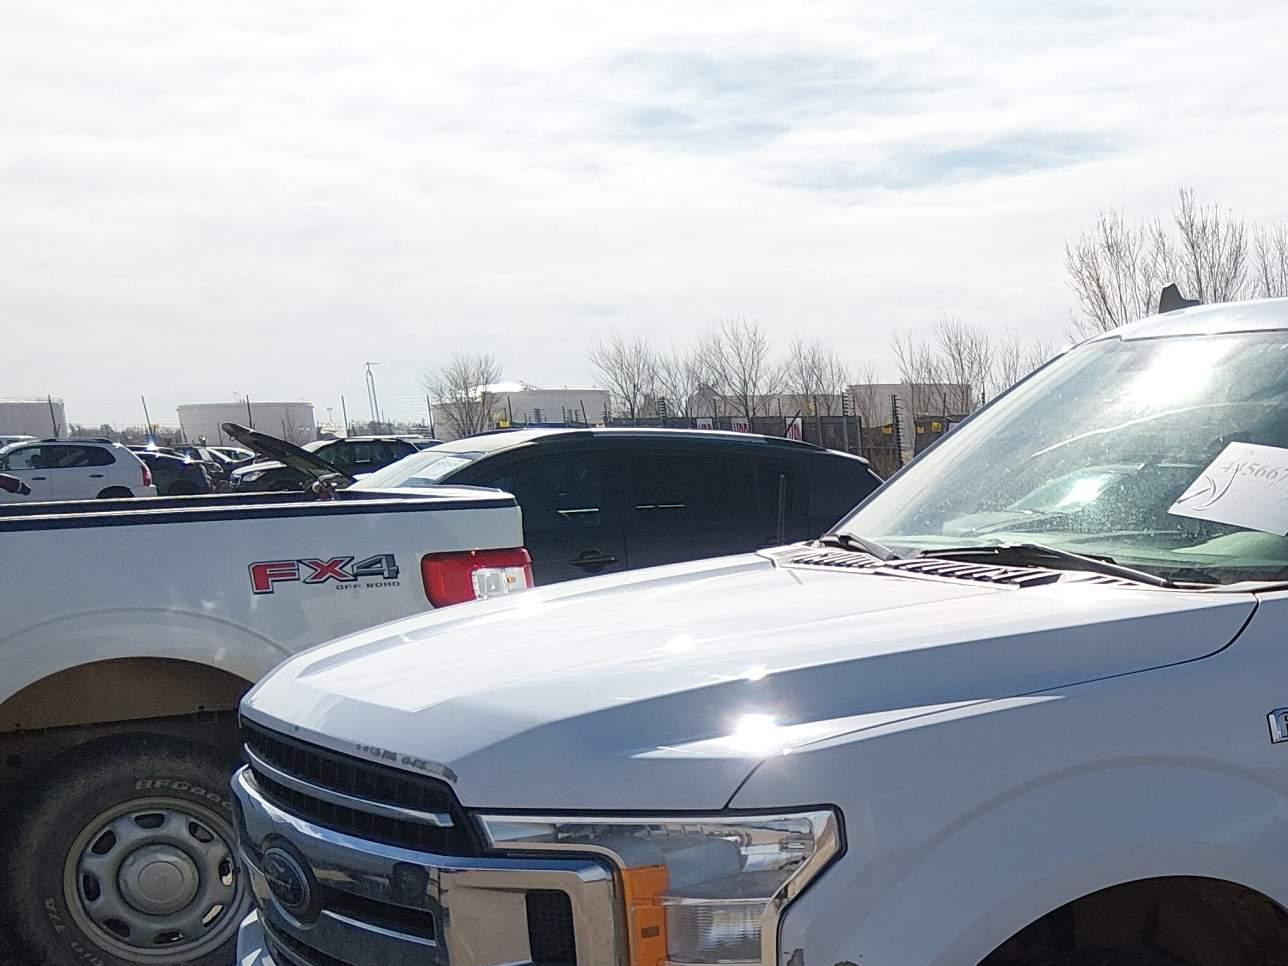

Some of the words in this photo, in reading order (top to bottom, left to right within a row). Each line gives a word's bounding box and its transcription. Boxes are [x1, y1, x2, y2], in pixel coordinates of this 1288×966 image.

[248, 553, 399, 595] FX4
[335, 583, 361, 591] OFF
[366, 581, 400, 589] ROAD
